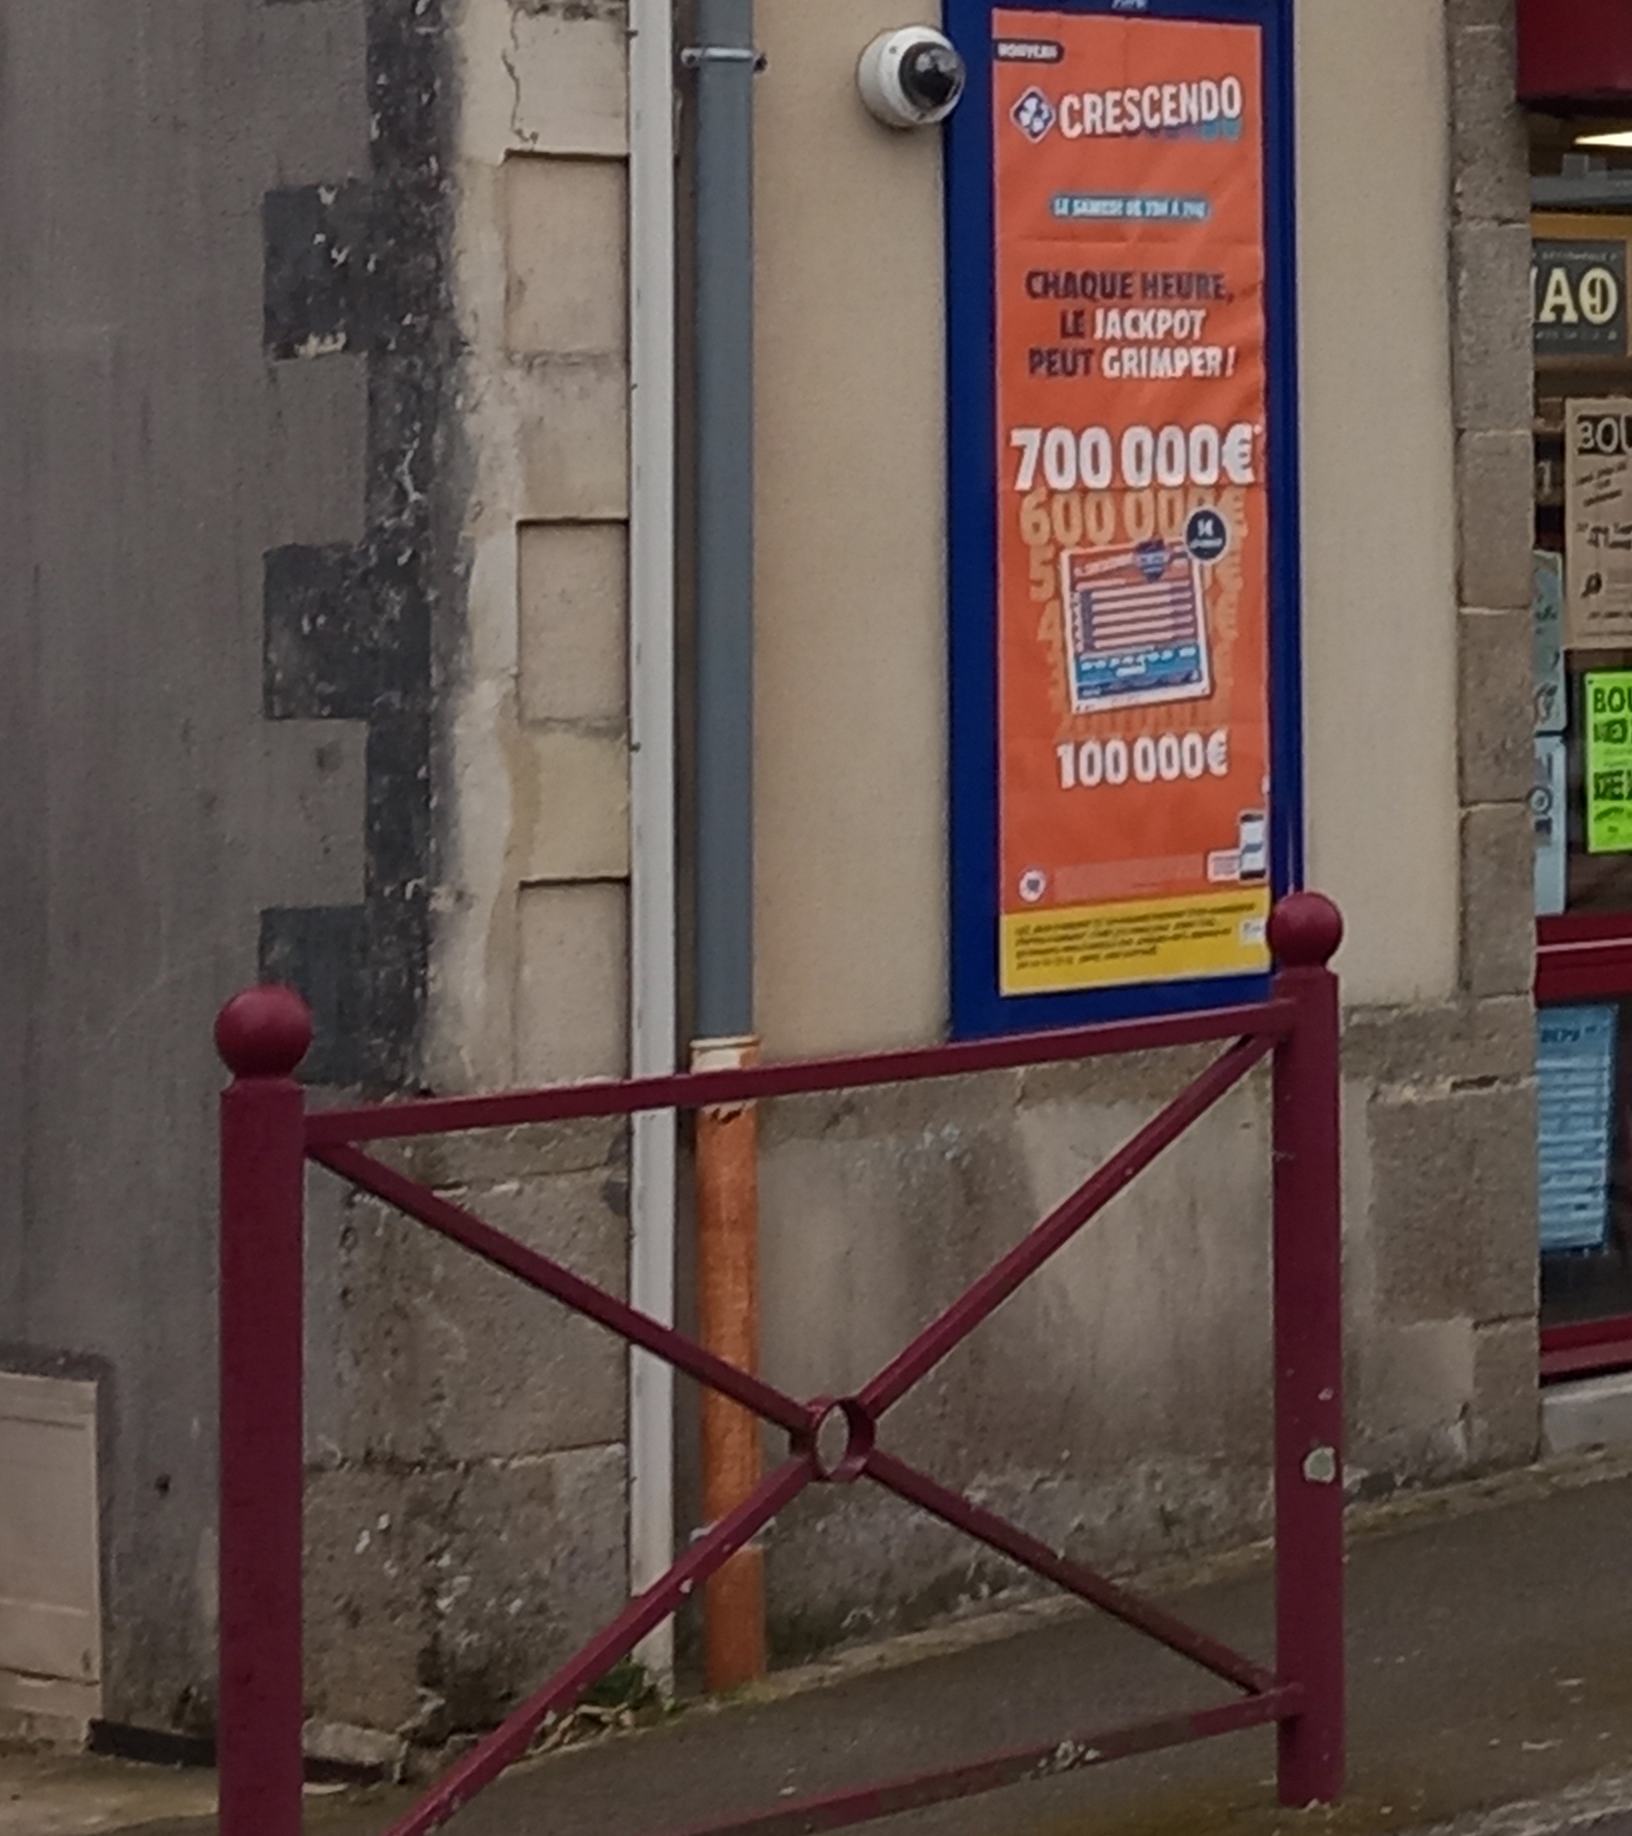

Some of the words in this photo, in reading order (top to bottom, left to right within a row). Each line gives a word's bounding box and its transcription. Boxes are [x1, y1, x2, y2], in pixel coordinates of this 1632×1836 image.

[1060, 76, 1243, 139] CRESCENDO
[1026, 270, 1132, 300] CHAQUE
[1060, 310, 1085, 339] LE
[1093, 308, 1206, 340] JACKPOT
[1029, 348, 1093, 378] PEUT
[1010, 426, 1112, 491] 700
[1019, 489, 1115, 547] 600
[1057, 741, 1128, 789] 100
[1134, 728, 1228, 781] 000€
